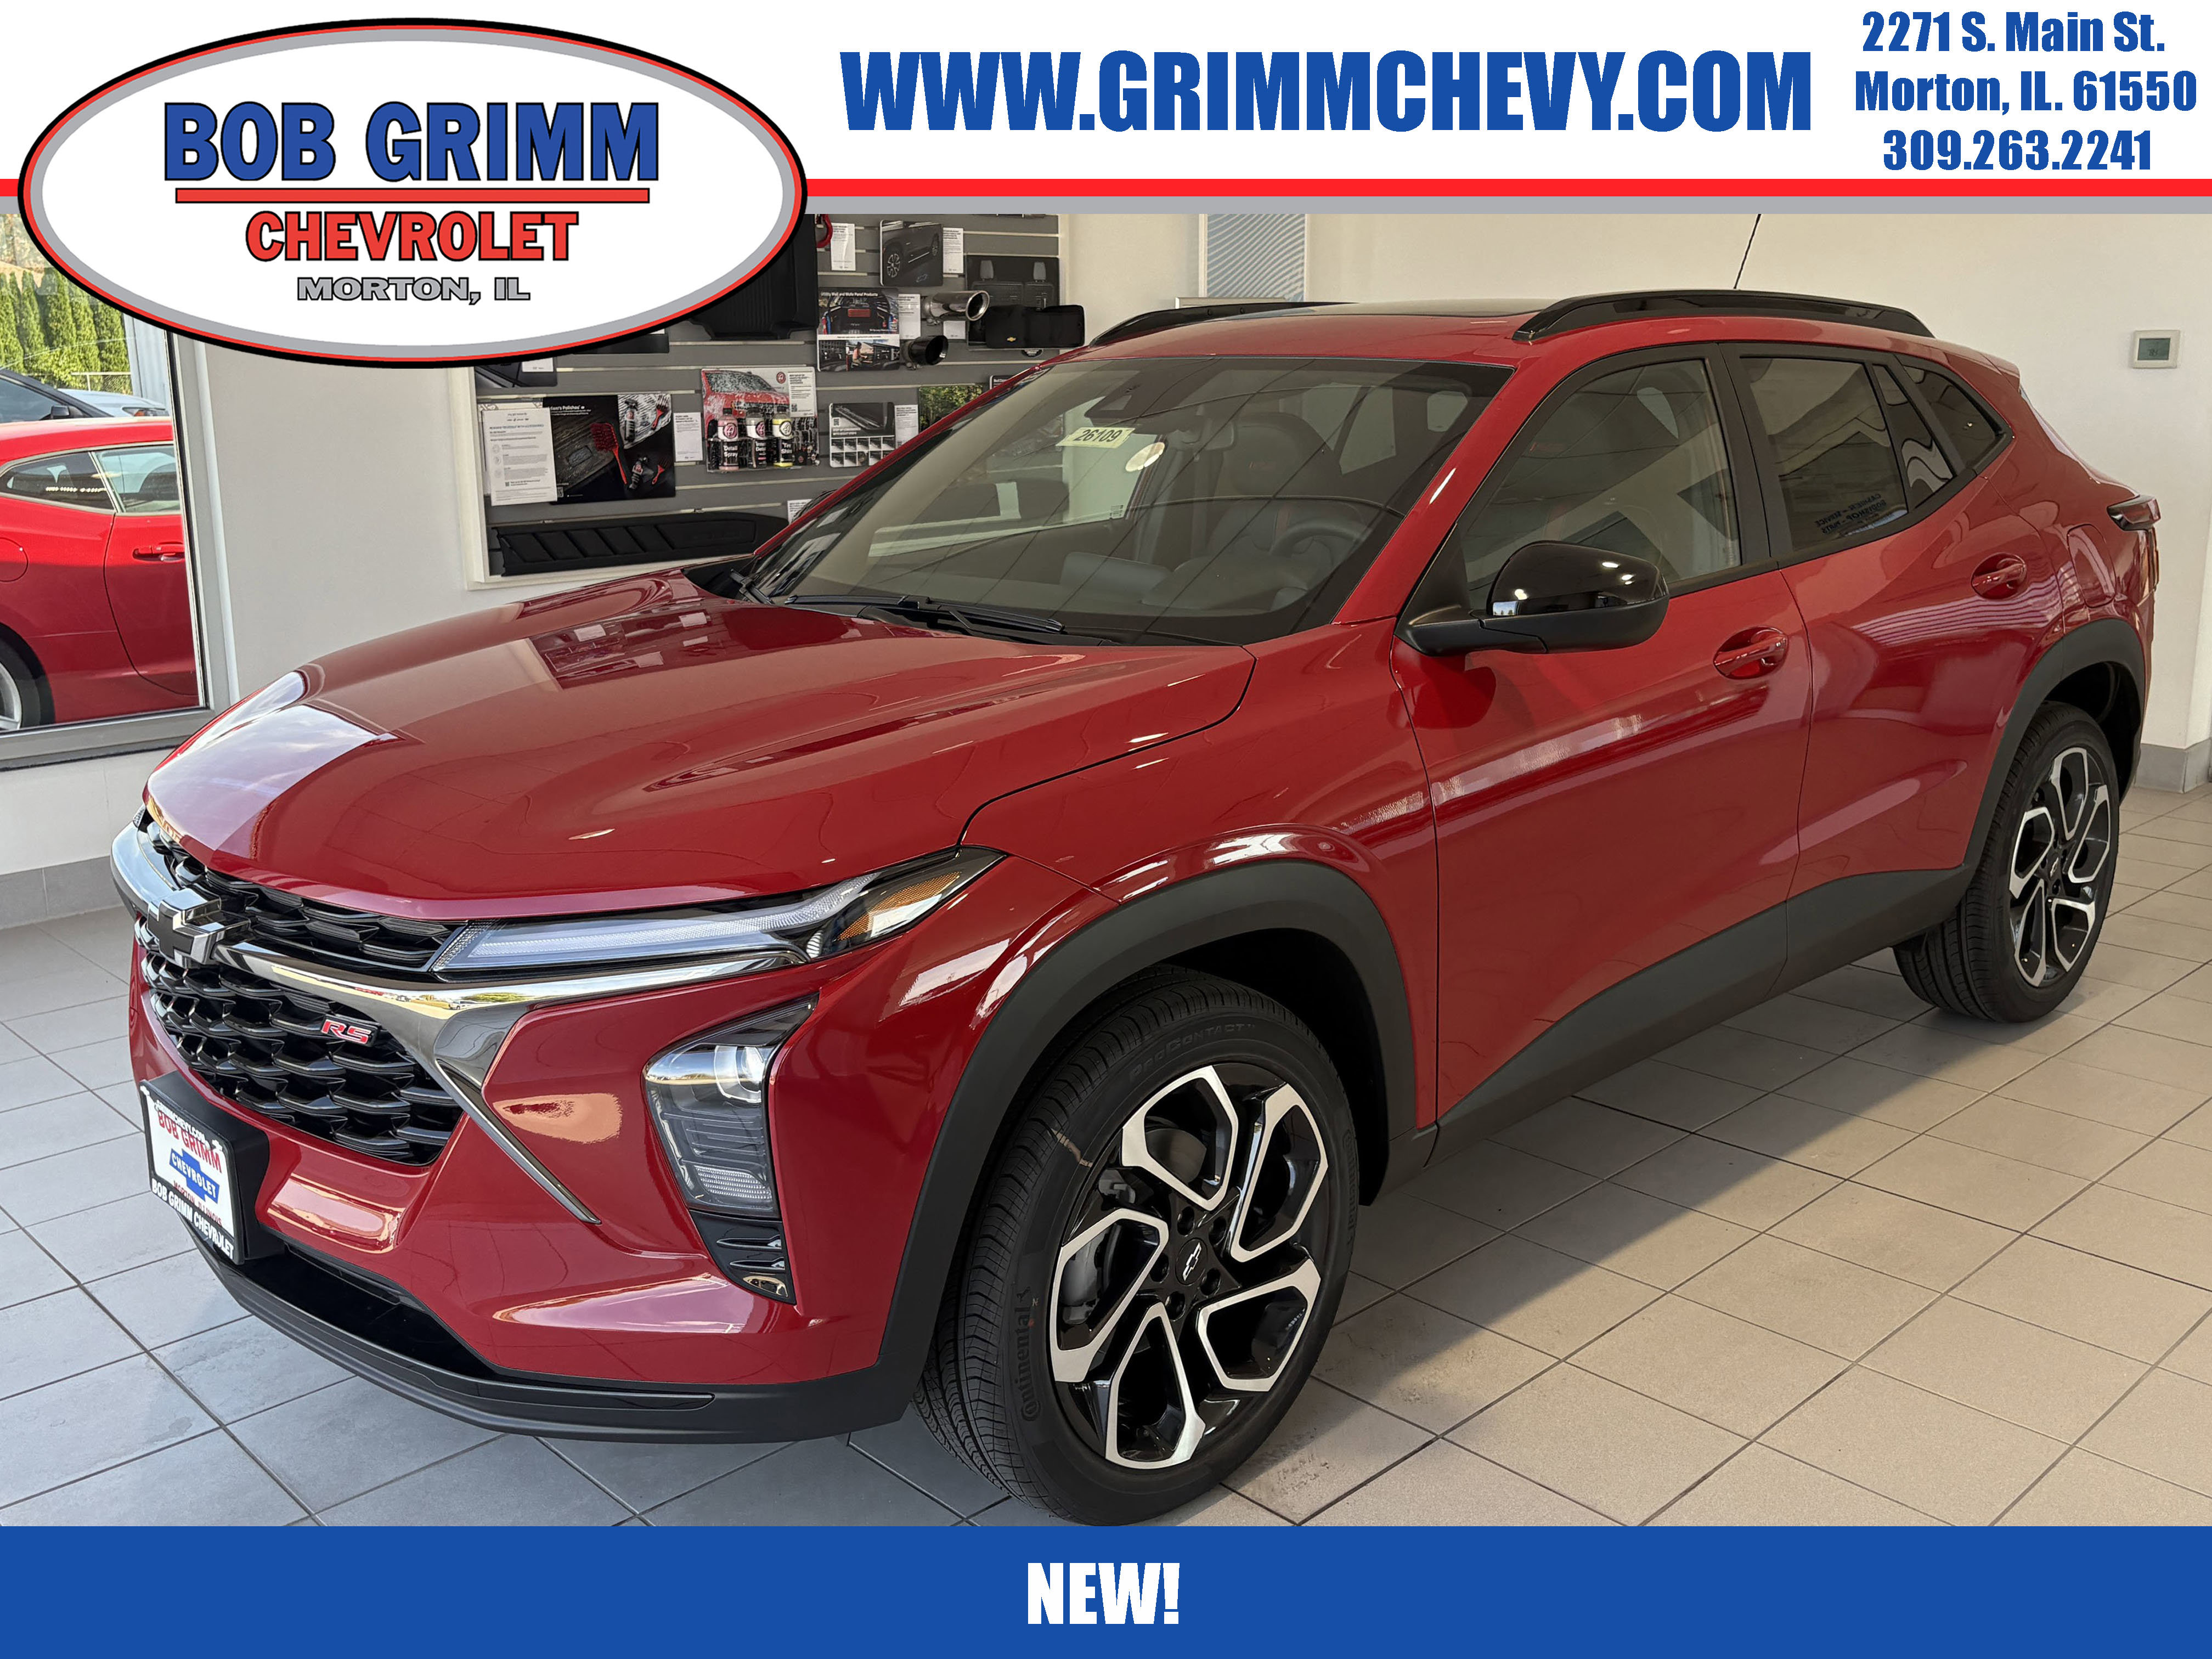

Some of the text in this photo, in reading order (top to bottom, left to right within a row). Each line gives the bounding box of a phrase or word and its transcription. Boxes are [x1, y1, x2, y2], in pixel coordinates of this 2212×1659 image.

[1073, 429, 1123, 442] 26109
[321, 1019, 372, 1045] RS
[158, 1110, 222, 1173] BOB GRIMM
[172, 1153, 217, 1199] CHEVROLET
[151, 1178, 234, 1260] BOB GRIMM CHEVROLET
